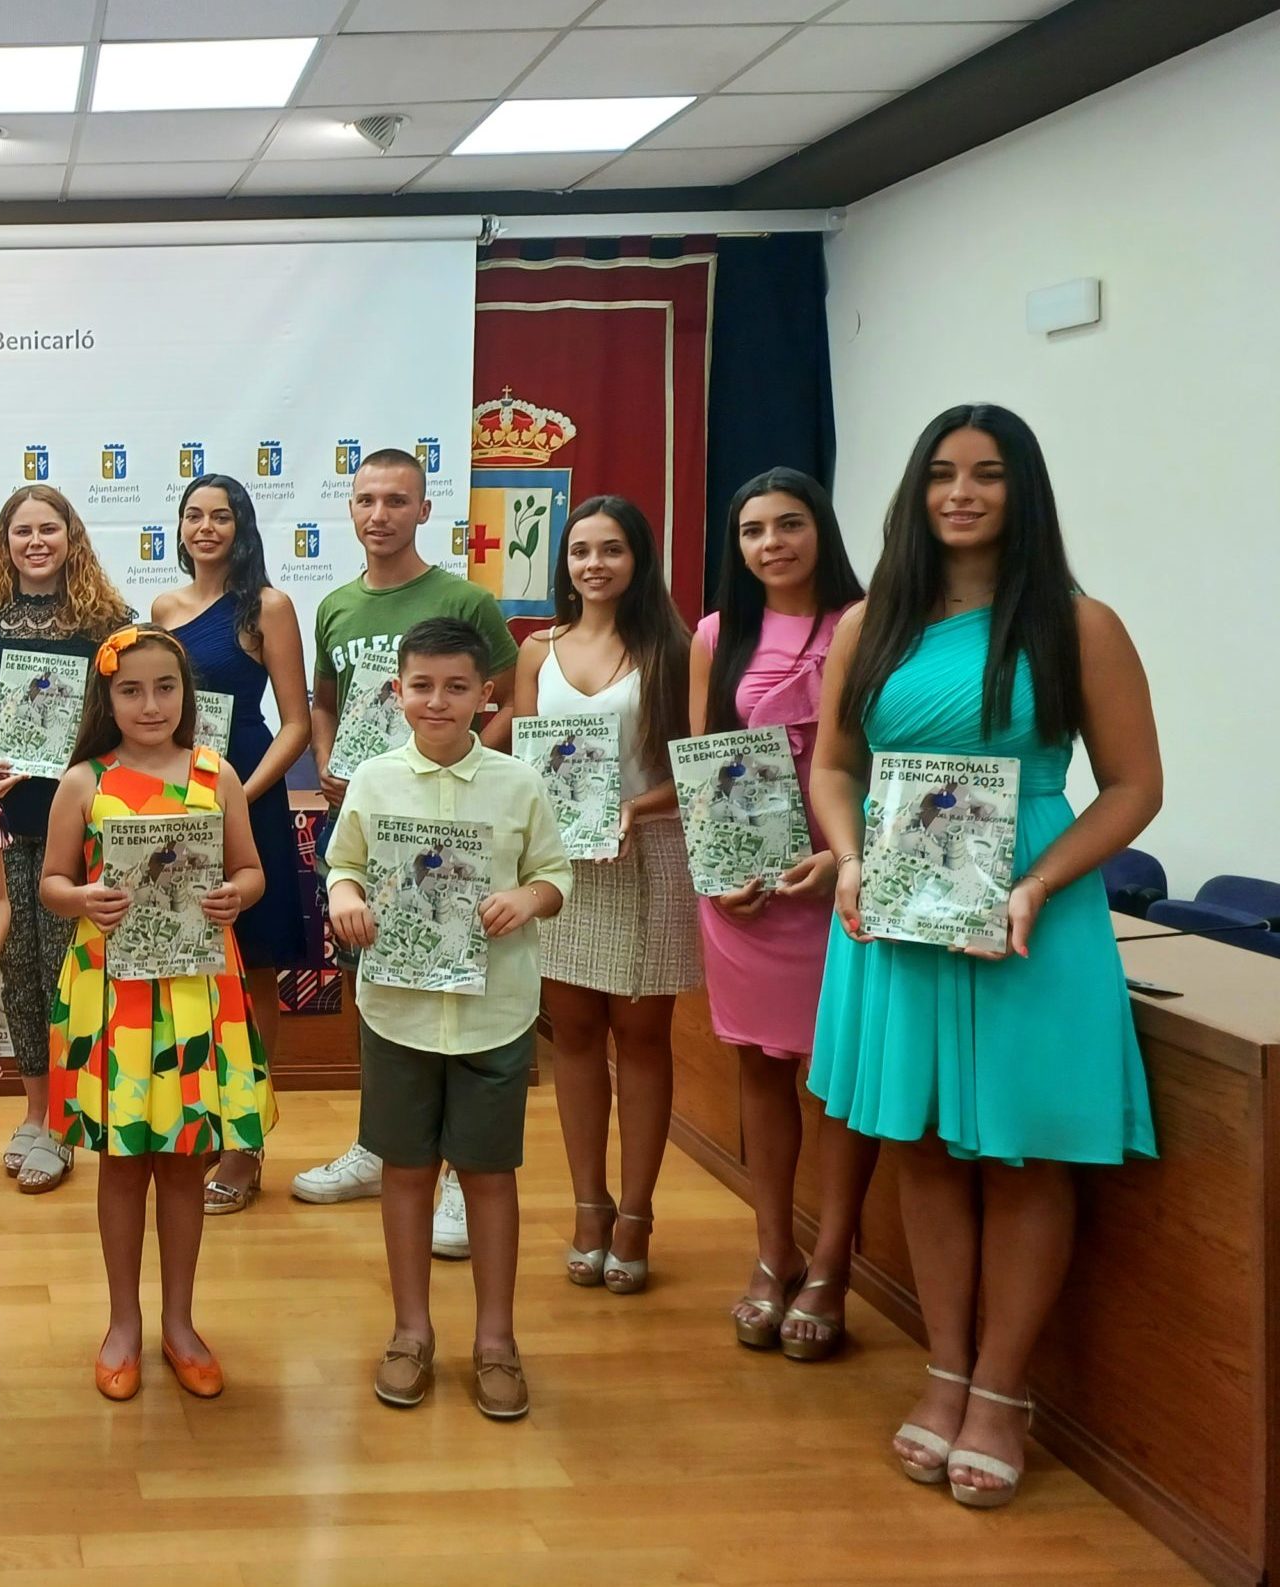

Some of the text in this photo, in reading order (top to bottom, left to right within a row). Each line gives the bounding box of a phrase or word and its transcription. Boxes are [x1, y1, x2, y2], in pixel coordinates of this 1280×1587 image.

[89, 484, 139, 494] Ajuntament
[322, 481, 353, 490] Ajunta
[88, 494, 141, 503] de Benicarló
[255, 490, 295, 500] Benicarló
[127, 566, 177, 575] Ajuntament
[282, 563, 332, 572] Ajuntament
[126, 576, 178, 584] de Benicarló
[281, 573, 333, 582] de Benicarló
[6, 654, 32, 663] FESTES
[363, 652, 388, 664] FESTES
[6, 662, 15, 670] DE
[60, 667, 79, 677] 2023
[361, 662, 399, 674] DE BENICA
[518, 720, 549, 729] FESTES
[518, 731, 530, 739] DE
[585, 727, 609, 737] 2023
[676, 732, 773, 753] FESTES PATRONALS
[678, 754, 691, 764] DE
[754, 742, 781, 754] 2023
[881, 758, 999, 774] FESTES PATRONALS
[880, 771, 1005, 787] DE BENICARLÓ 2023
[111, 822, 209, 834] FESTES PATRONALS
[378, 820, 478, 838] FESTES PATRONALS
[111, 832, 214, 846] DE BENICARLÓ 2023
[377, 832, 483, 850] DE BENICARLÓ 2023
